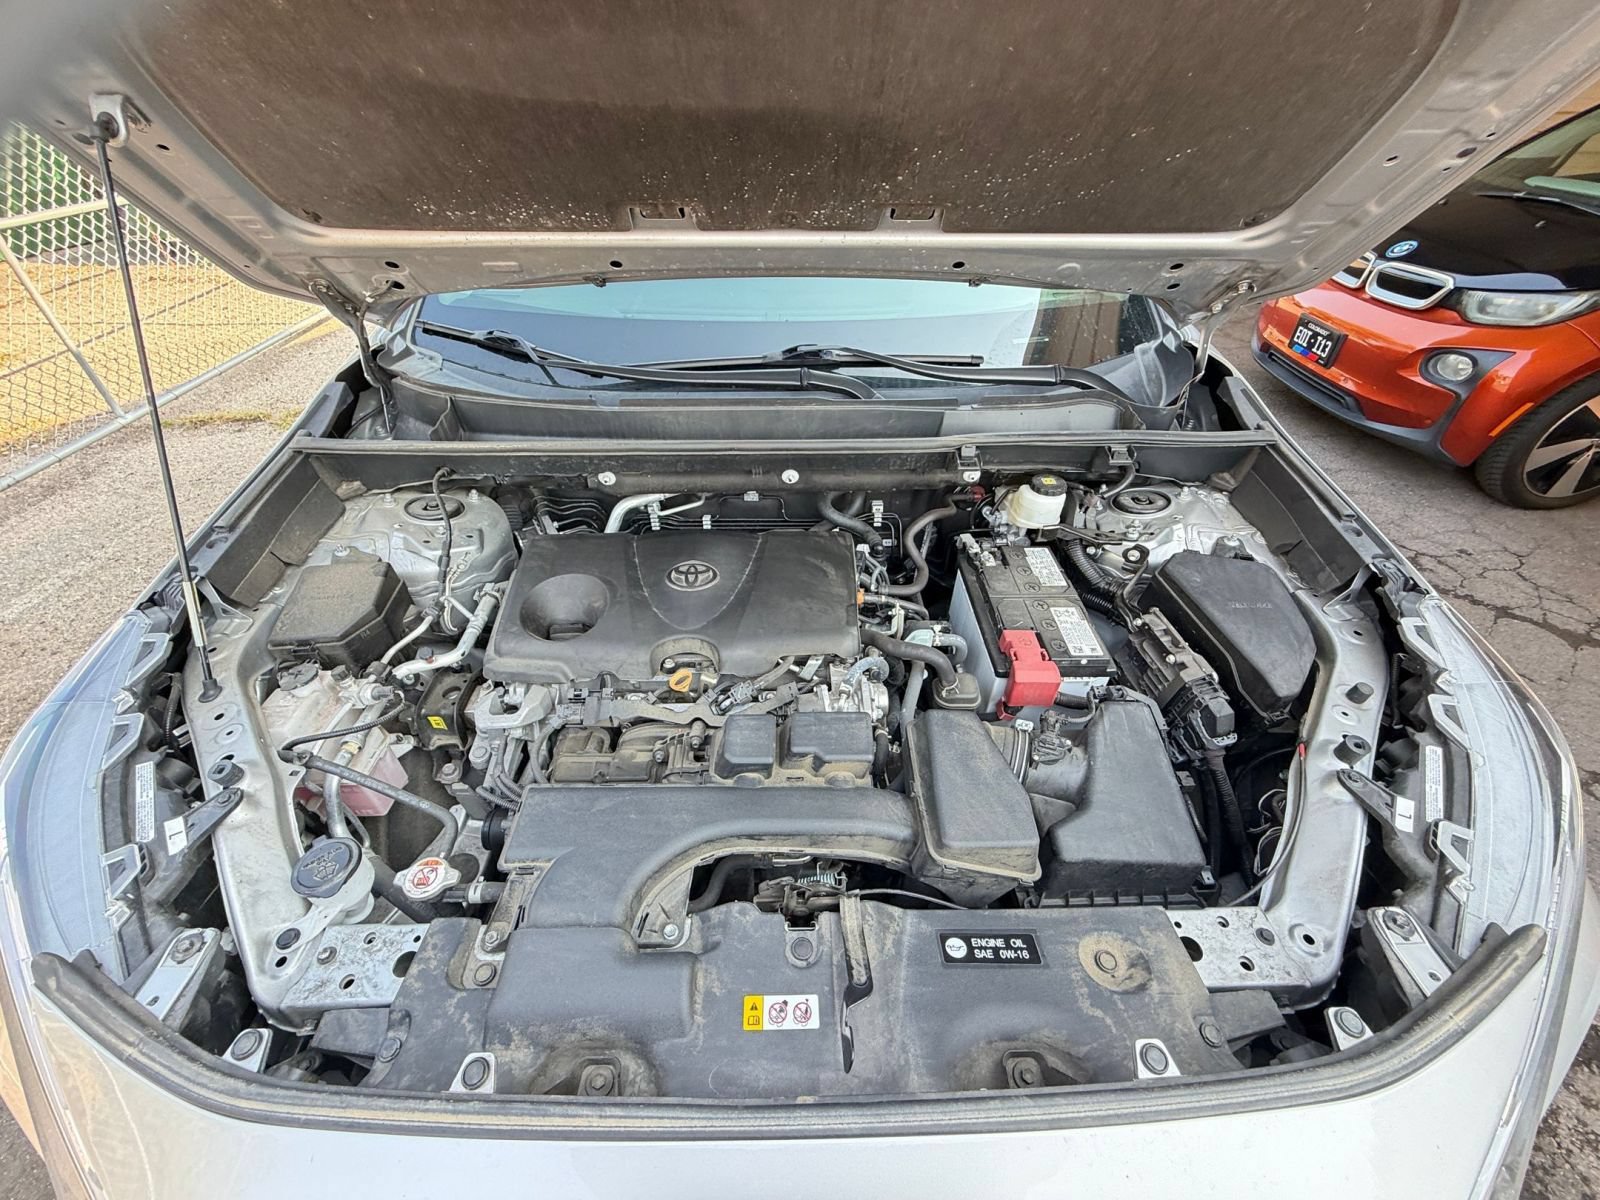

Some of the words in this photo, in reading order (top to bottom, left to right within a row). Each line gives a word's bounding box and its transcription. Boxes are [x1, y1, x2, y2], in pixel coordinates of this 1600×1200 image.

[971, 937, 1006, 948] ENGINE
[1009, 938, 1027, 948] OIL
[973, 949, 995, 959] SAE
[999, 949, 1030, 960] 0W-16
